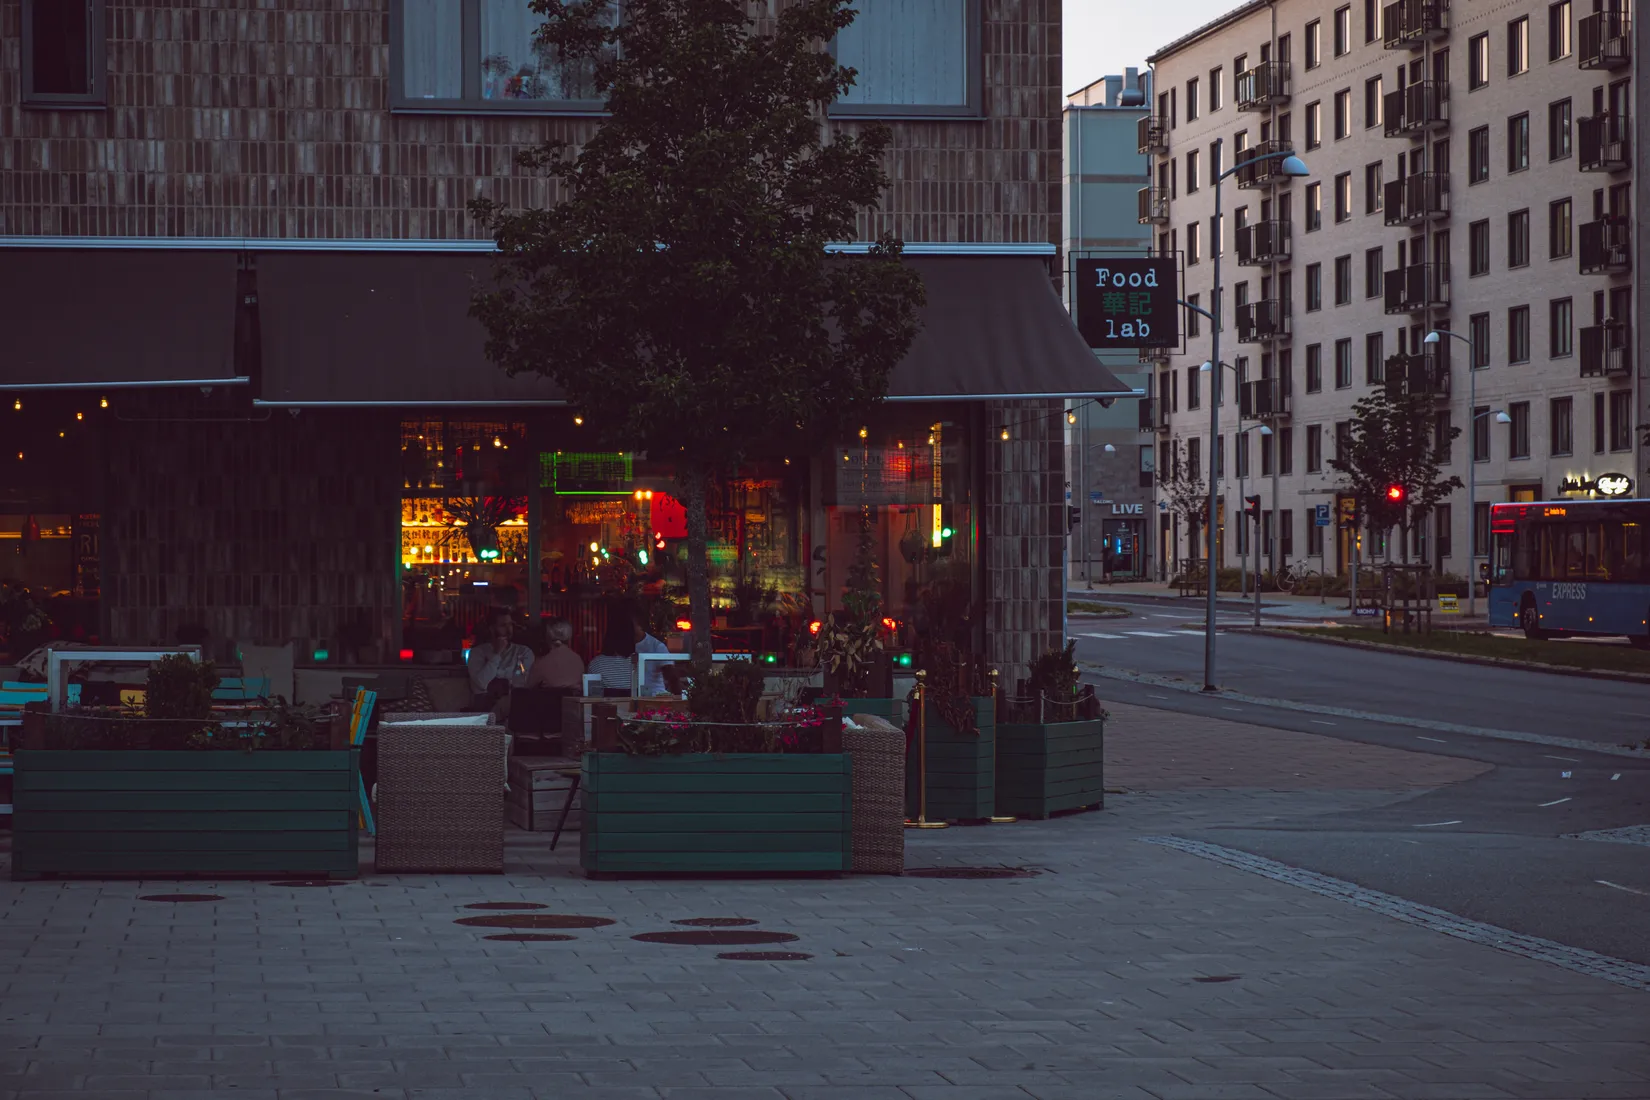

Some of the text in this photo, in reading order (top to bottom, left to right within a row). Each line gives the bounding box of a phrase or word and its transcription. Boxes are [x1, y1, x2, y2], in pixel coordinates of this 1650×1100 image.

[1095, 268, 1158, 287] Food
[1102, 291, 1152, 315] 華記
[1105, 319, 1150, 338] lab
[1112, 503, 1144, 514] LIVE
[1319, 506, 1328, 517] P
[1552, 583, 1586, 600] EXPRESS
